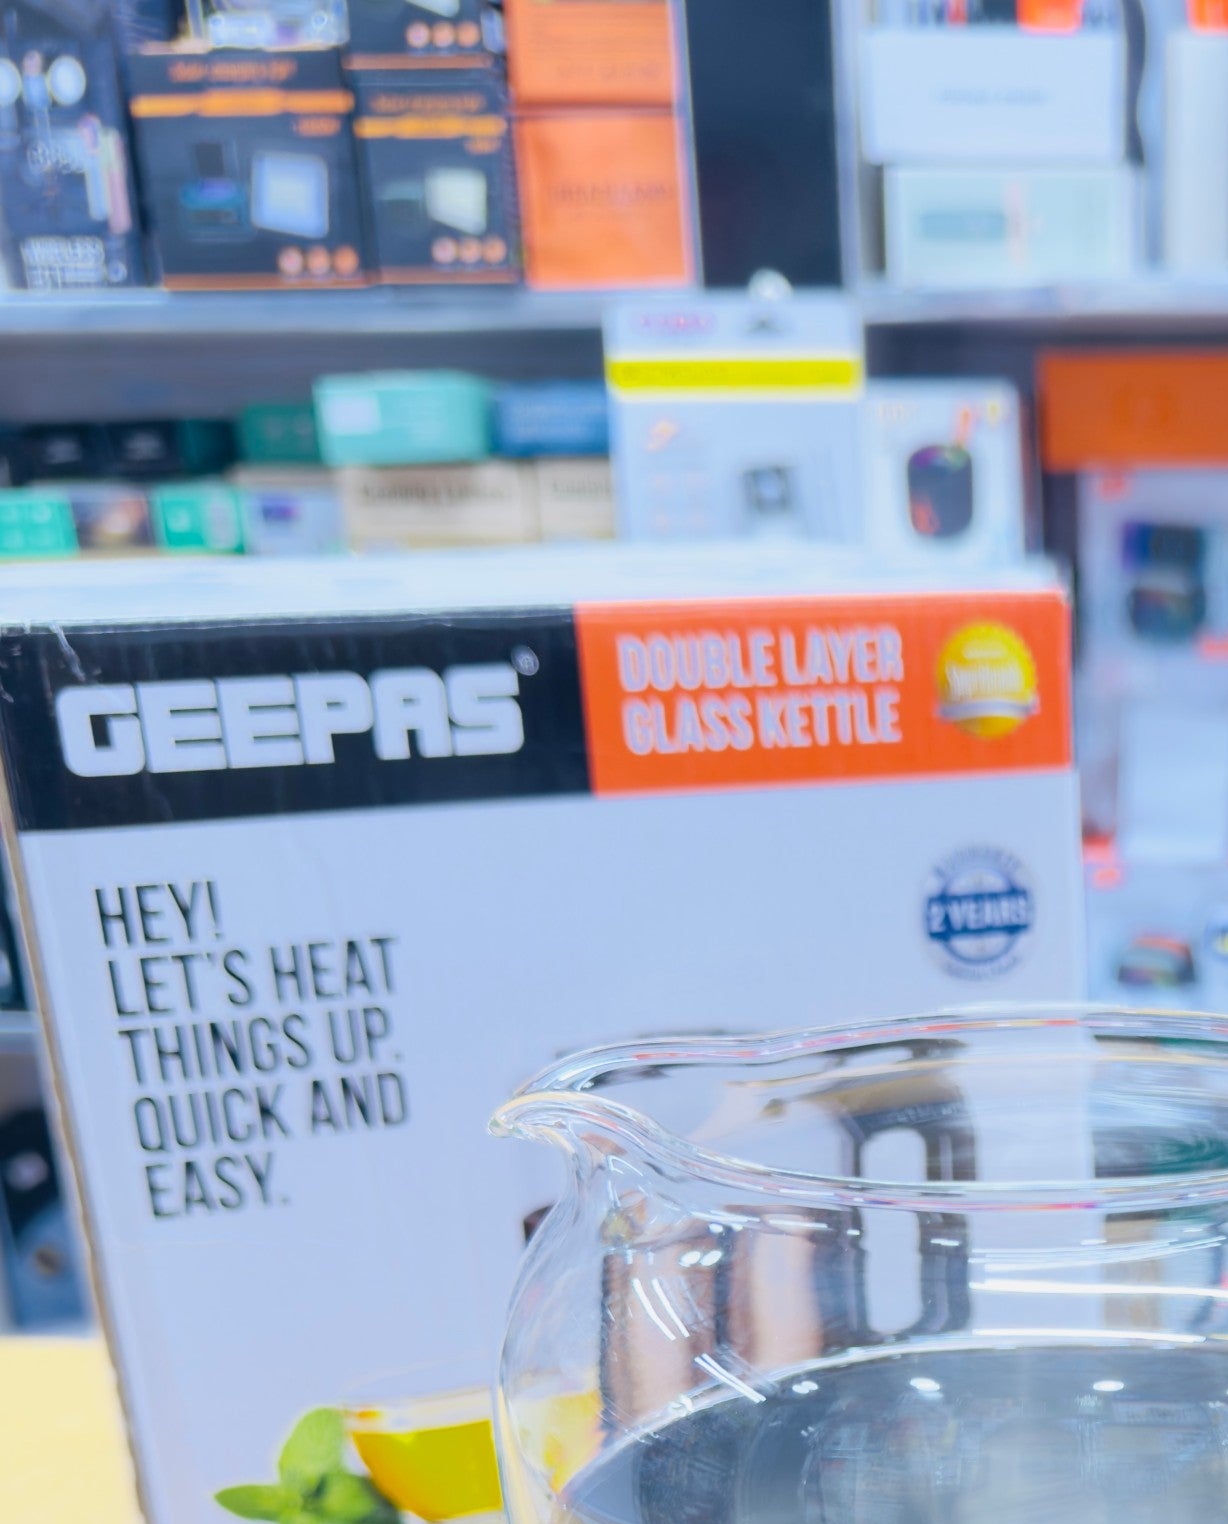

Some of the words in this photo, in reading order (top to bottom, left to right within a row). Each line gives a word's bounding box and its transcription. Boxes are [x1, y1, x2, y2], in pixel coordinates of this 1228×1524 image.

[616, 629, 777, 692] DOUBLE
[779, 624, 905, 686] LAYER
[622, 693, 754, 756] GLASS
[756, 686, 903, 749] KETTLE
[95, 880, 222, 947] HEY!
[930, 902, 944, 933] 2
[945, 897, 1027, 931] YEARS
[107, 949, 255, 1017] LET'S
[269, 938, 398, 1001] HEAT
[118, 1013, 313, 1086] THINGS
[133, 1084, 292, 1153] QUICK
[310, 1072, 409, 1136] AND
[145, 1151, 291, 1220] EASY.
